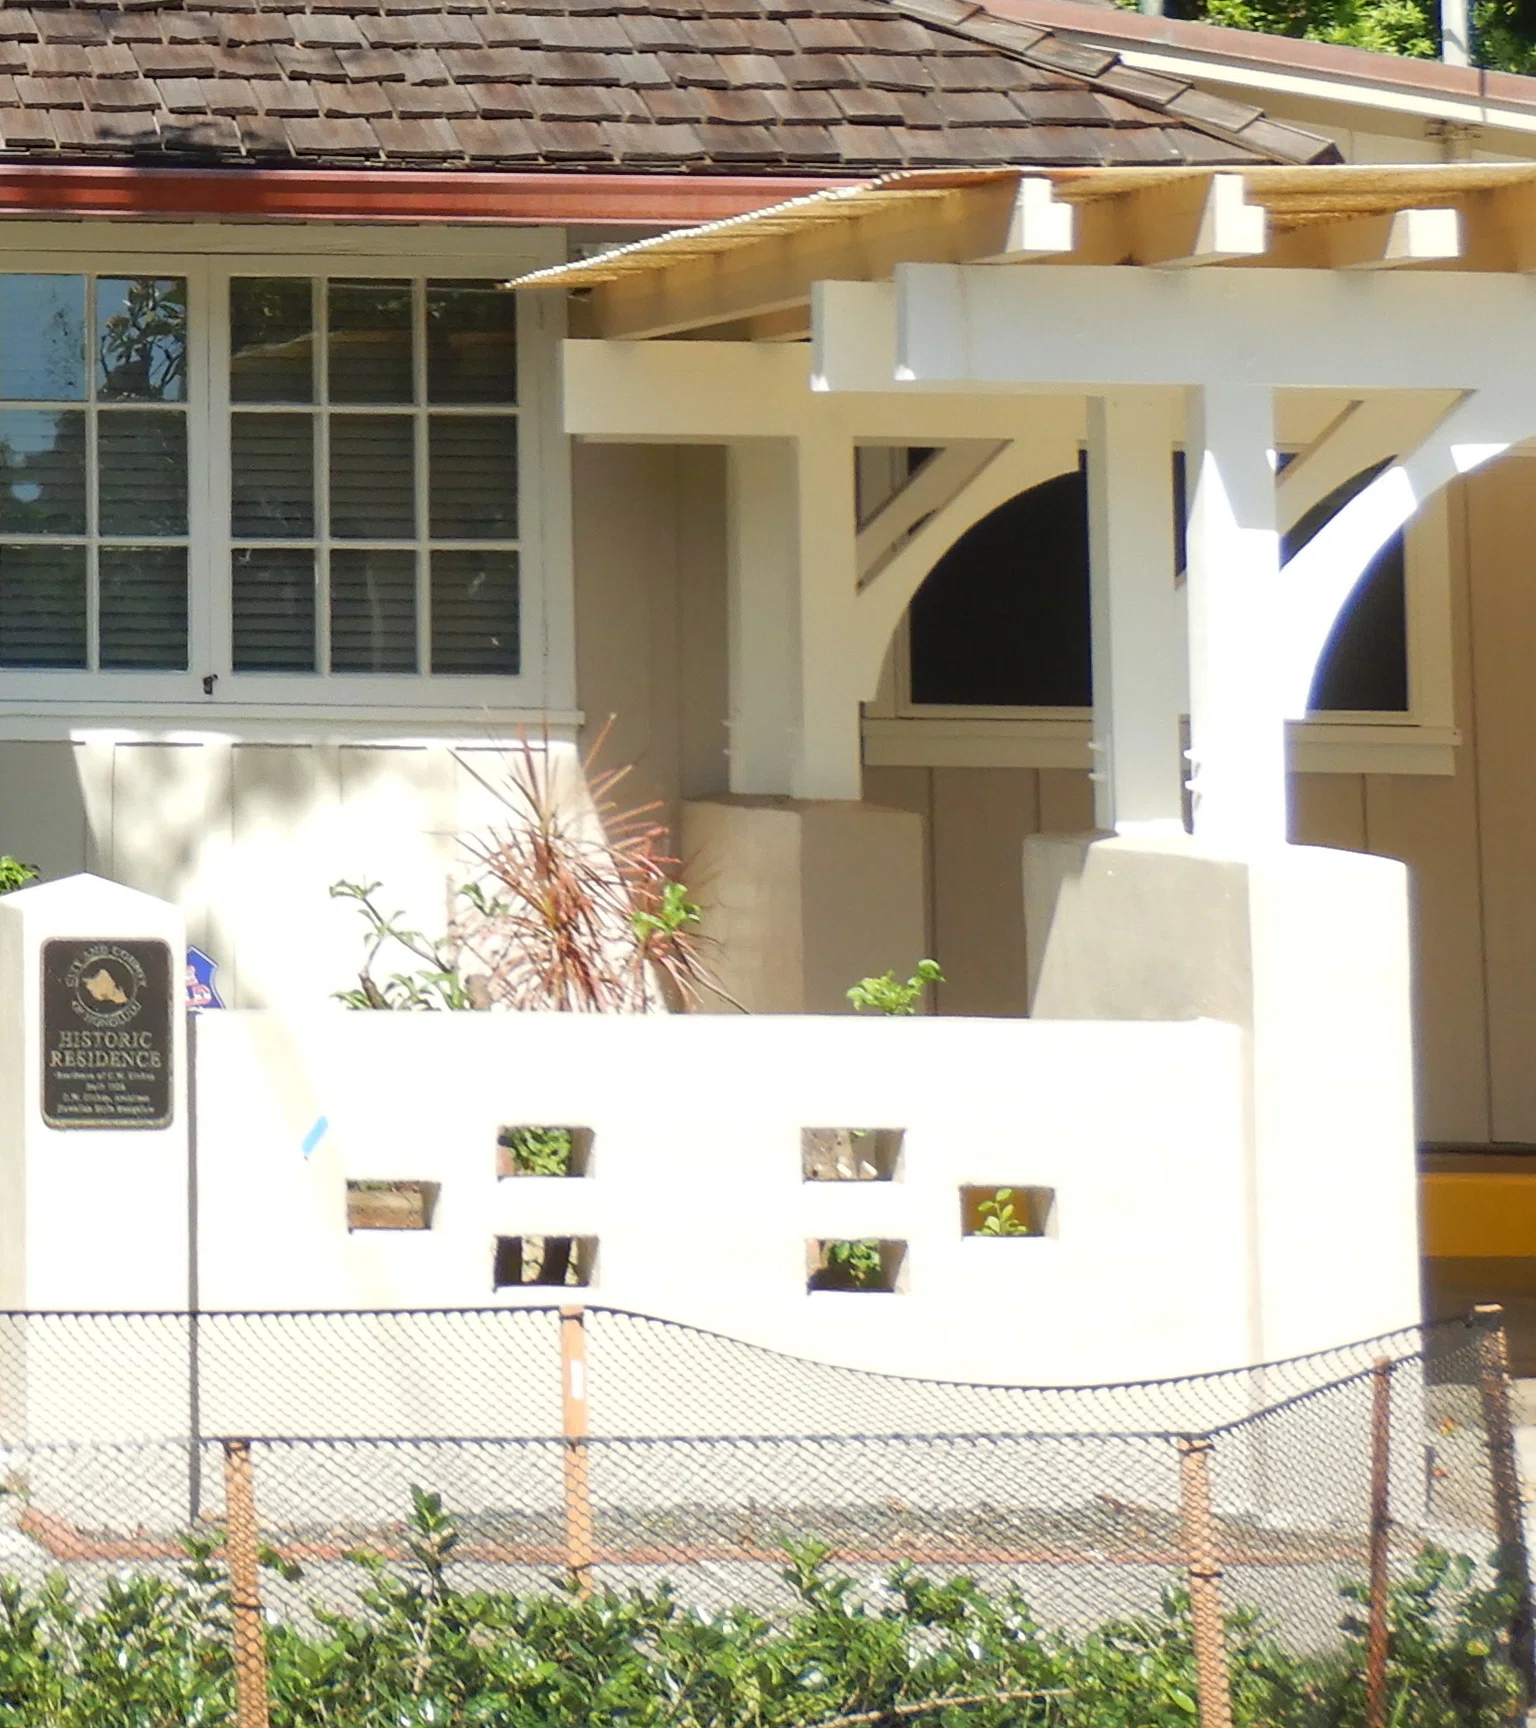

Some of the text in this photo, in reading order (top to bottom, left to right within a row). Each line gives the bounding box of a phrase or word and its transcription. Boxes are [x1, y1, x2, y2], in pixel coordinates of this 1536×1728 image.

[84, 943, 108, 957] AND
[58, 1031, 153, 1048] HISTORIC
[49, 1049, 162, 1068] RESIDENCE
